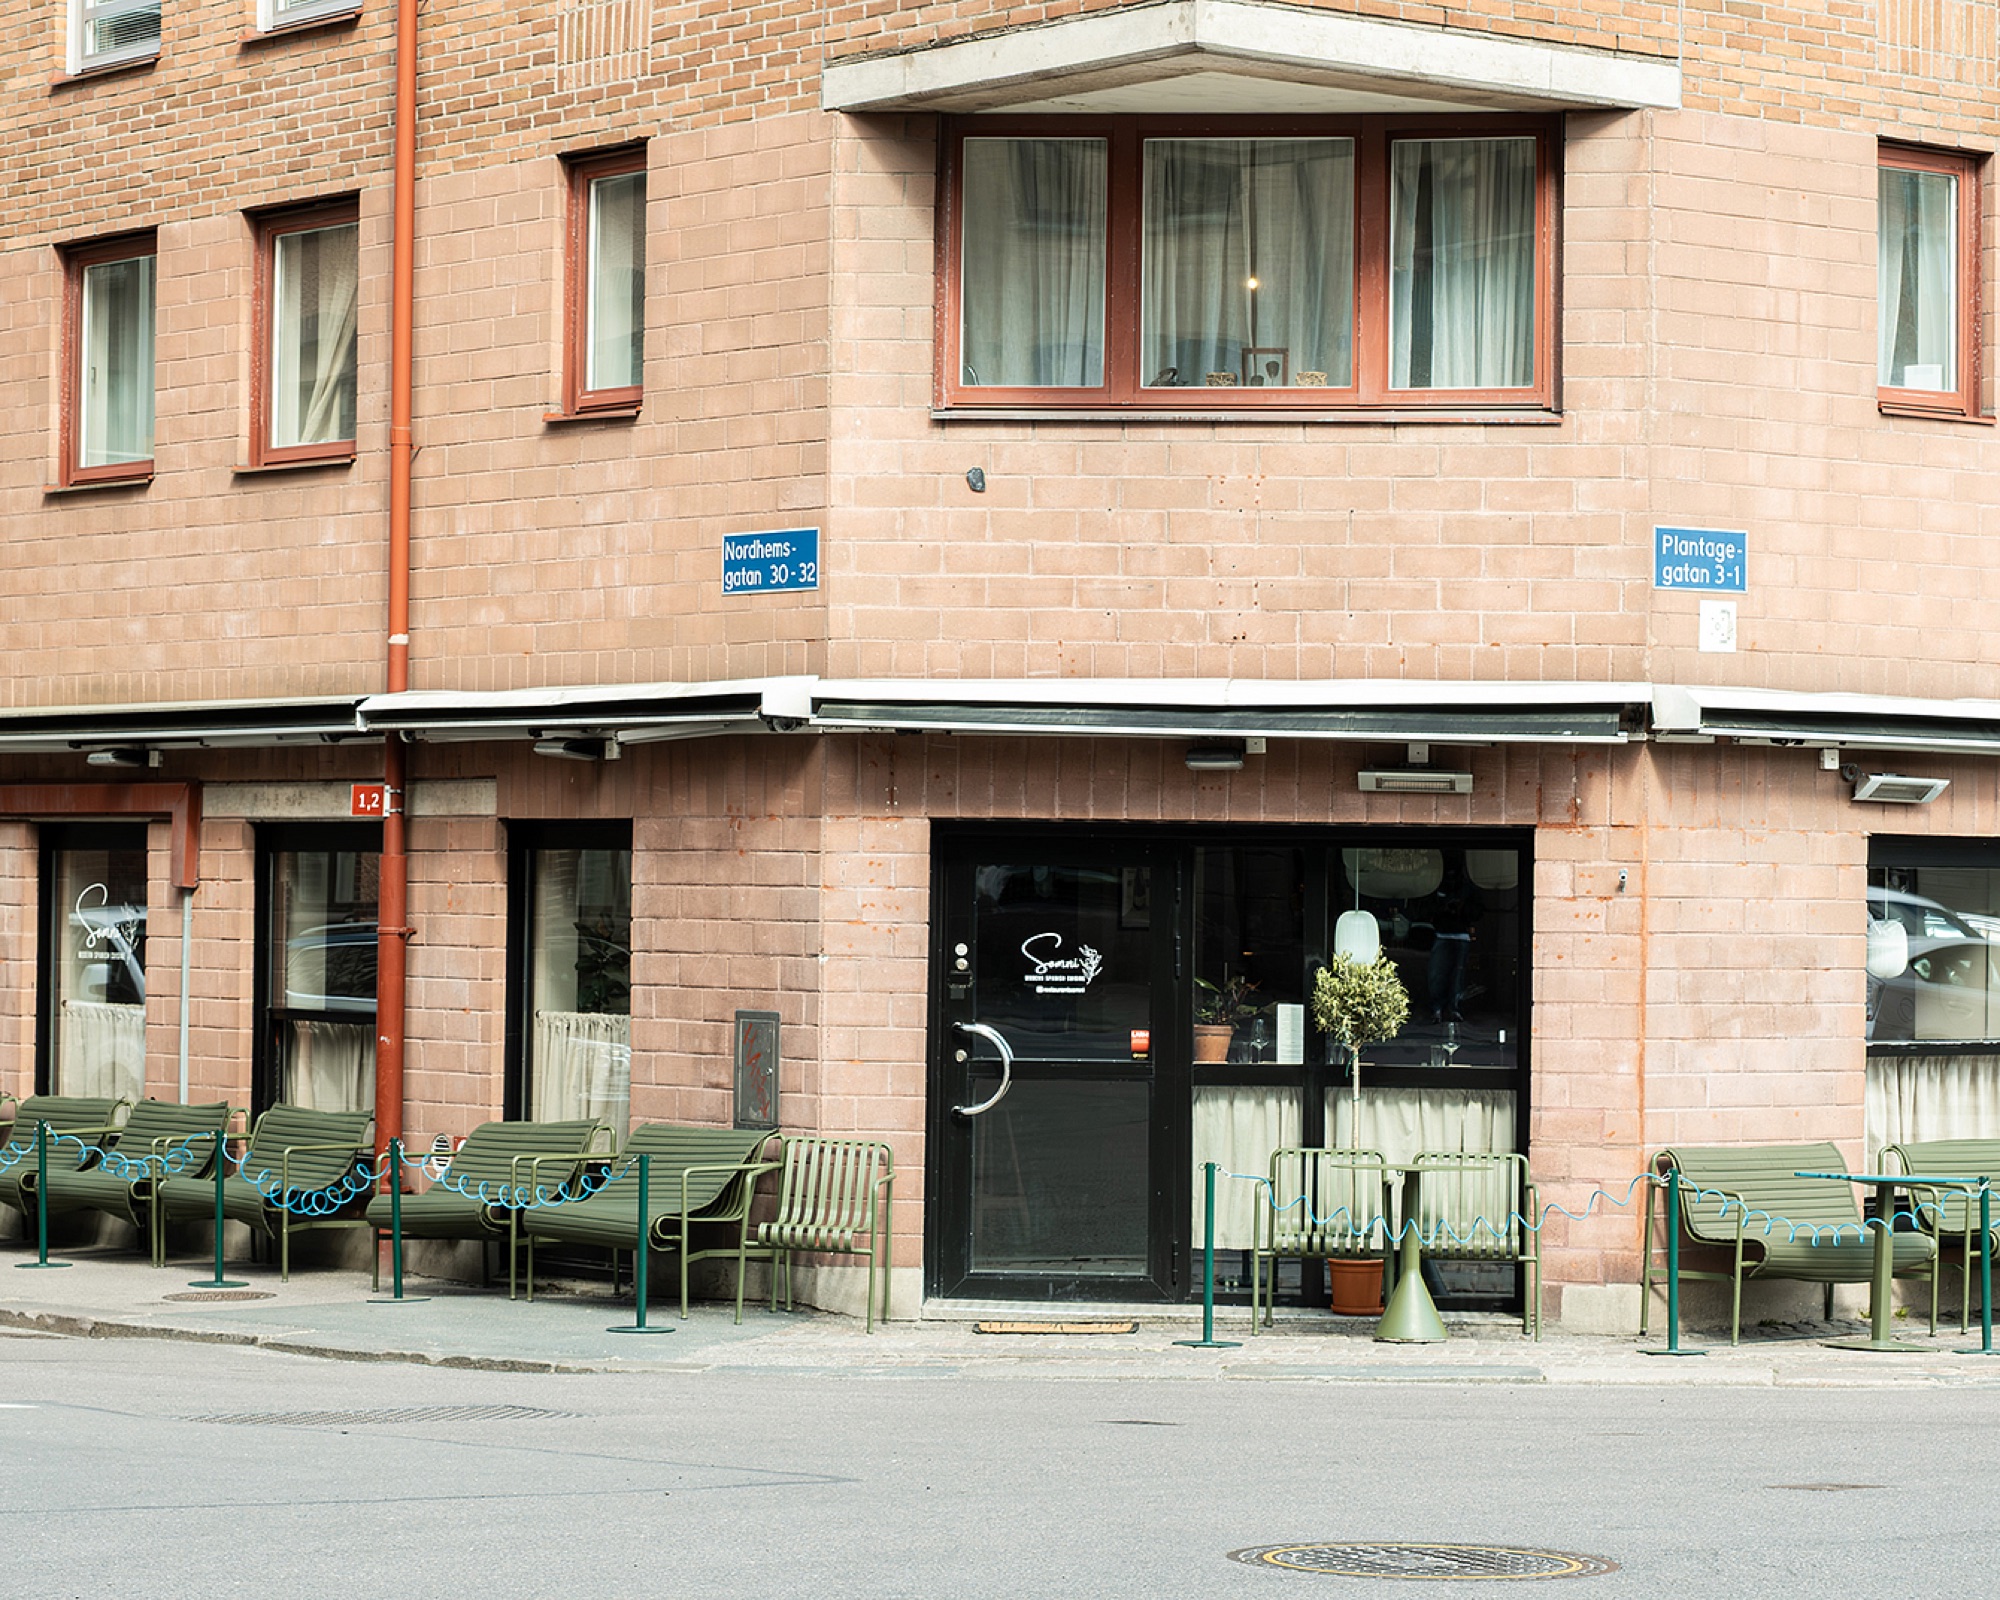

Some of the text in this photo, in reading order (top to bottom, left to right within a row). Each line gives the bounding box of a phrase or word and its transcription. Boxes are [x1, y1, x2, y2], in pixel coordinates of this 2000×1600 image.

[725, 539, 797, 561] Nordhems-
[1662, 533, 1743, 563] Plantage-
[725, 566, 762, 591] gatan
[1662, 562, 1740, 586] gatan 3-1
[358, 792, 380, 812] 1,2
